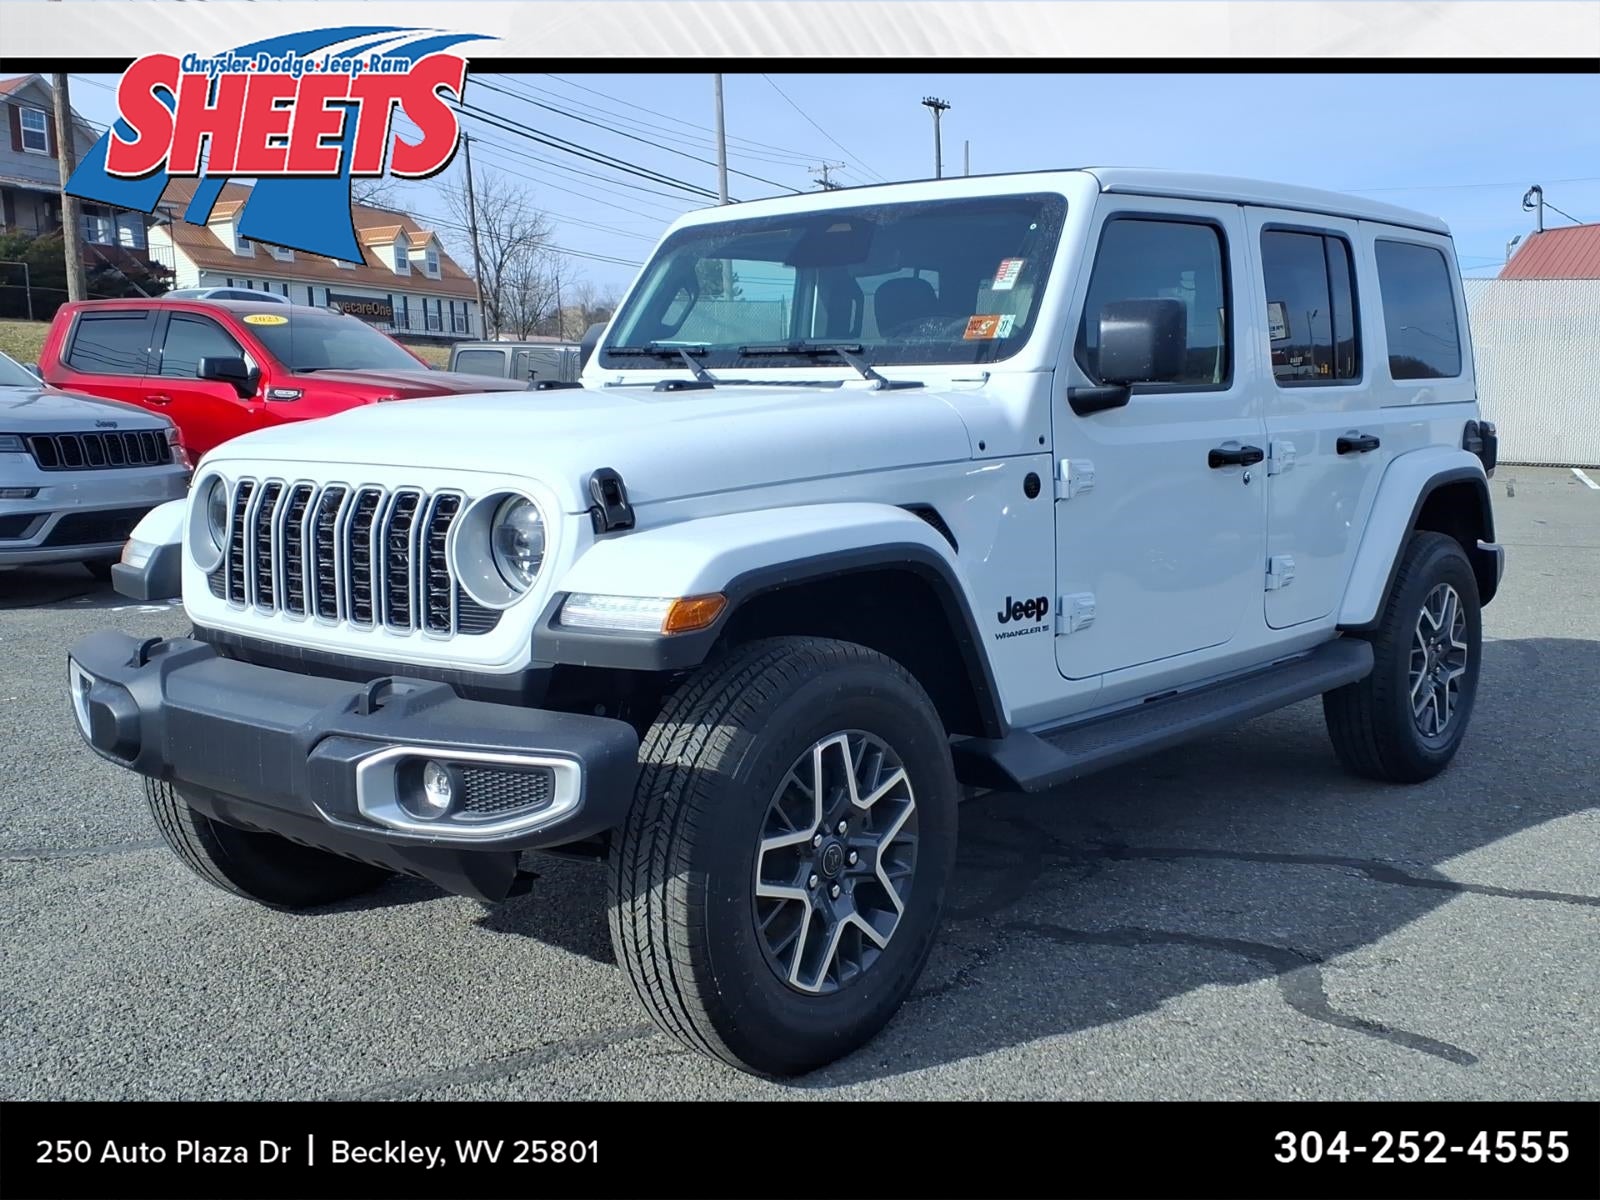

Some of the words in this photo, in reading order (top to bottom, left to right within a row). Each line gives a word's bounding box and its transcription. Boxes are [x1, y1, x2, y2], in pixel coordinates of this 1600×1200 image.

[337, 301, 392, 316] yecareOne
[997, 596, 1049, 624] Jeep
[994, 626, 1041, 640] WRANGLER
